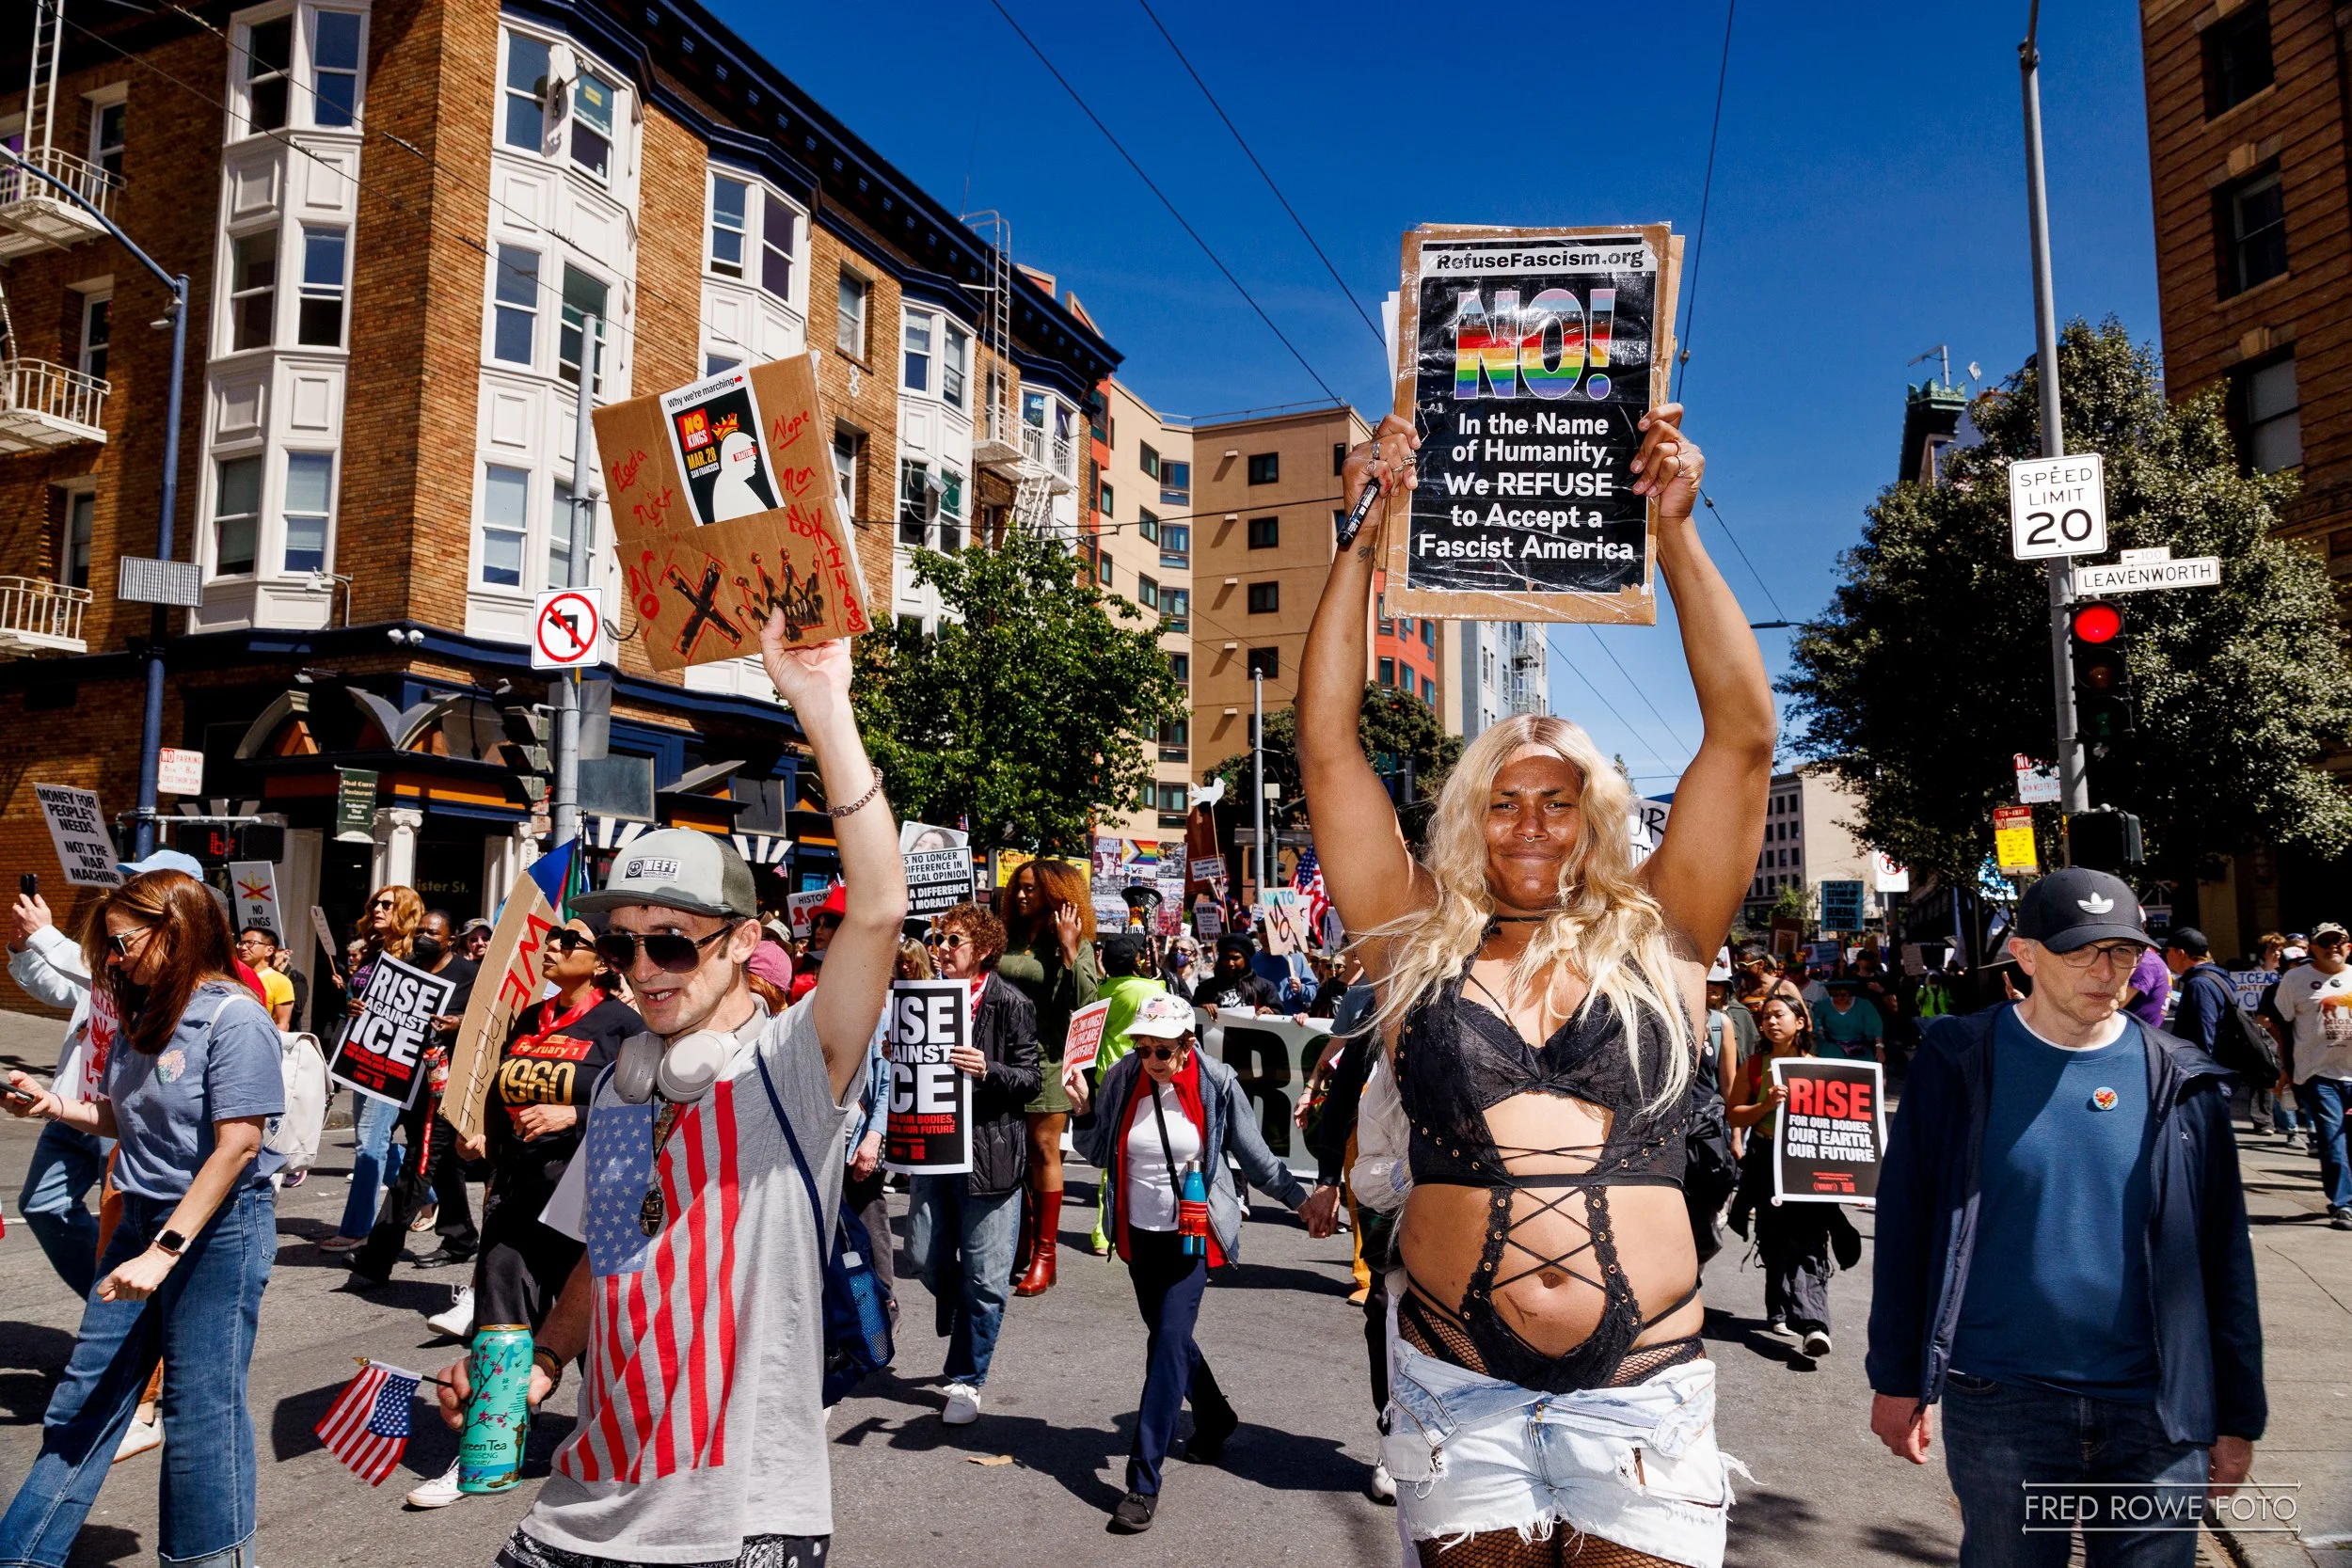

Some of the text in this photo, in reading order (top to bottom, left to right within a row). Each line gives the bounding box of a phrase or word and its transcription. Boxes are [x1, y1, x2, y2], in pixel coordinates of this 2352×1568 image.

[1437, 249, 1645, 270] RefuseFascism.org
[1454, 289, 1616, 401] NO!
[667, 377, 735, 408] Why we're marching
[684, 414, 704, 435] NO
[1459, 412, 1609, 436] In the Name
[687, 430, 708, 449] KINGS
[687, 447, 717, 470] MAR. 28
[1452, 439, 1613, 469] of Humanity,
[691, 469, 699, 479] SAN
[2020, 467, 2092, 487] SPEED
[1443, 472, 1613, 497] We REFUSE
[2029, 487, 2085, 506] LIMIT
[1451, 502, 1603, 534] to Accept a
[2026, 508, 2093, 546] 20
[1419, 533, 1634, 561] Fascist America
[2084, 563, 2211, 588] LEAVENWORTH
[162, 751, 173, 762] NO
[38, 788, 96, 809] MONEY FOR
[48, 804, 96, 822] PEOPLE'S
[58, 818, 99, 836] NEEDS,
[1995, 818, 2031, 830] NO STOPPING
[64, 841, 109, 858] NOT THE
[927, 852, 958, 862] LONGER
[79, 855, 106, 870] WAR
[644, 860, 677, 873] NEFF
[954, 861, 962, 869] IN
[906, 870, 967, 883] ITICAL OPINION
[417, 880, 449, 894] ister
[910, 883, 969, 898] A DIFFERENCE
[798, 893, 829, 905] HISTOR
[252, 905, 263, 915] NO
[246, 916, 271, 927] KINGS
[368, 963, 440, 1022] RISE
[364, 997, 432, 1034] AGAINST
[890, 996, 955, 1044] ISE
[349, 1010, 424, 1069] ICE
[890, 1045, 955, 1064] AINST
[386, 1067, 410, 1082] FUTURE
[459, 1006, 502, 1132] PEOPLE
[499, 1058, 576, 1106] 1960
[890, 1064, 957, 1114] CE
[1788, 1078, 1872, 1121] RISE
[898, 1115, 914, 1123] OUR
[916, 1114, 955, 1125] BODIES,
[902, 1124, 955, 1134] OUR FUTURE
[1788, 1115, 1872, 1133] FOR OUR BODIES,
[1788, 1129, 1819, 1144] OUR
[1788, 1143, 1875, 1163] OUR FUTURE
[461, 1436, 507, 1450] Green Tea
